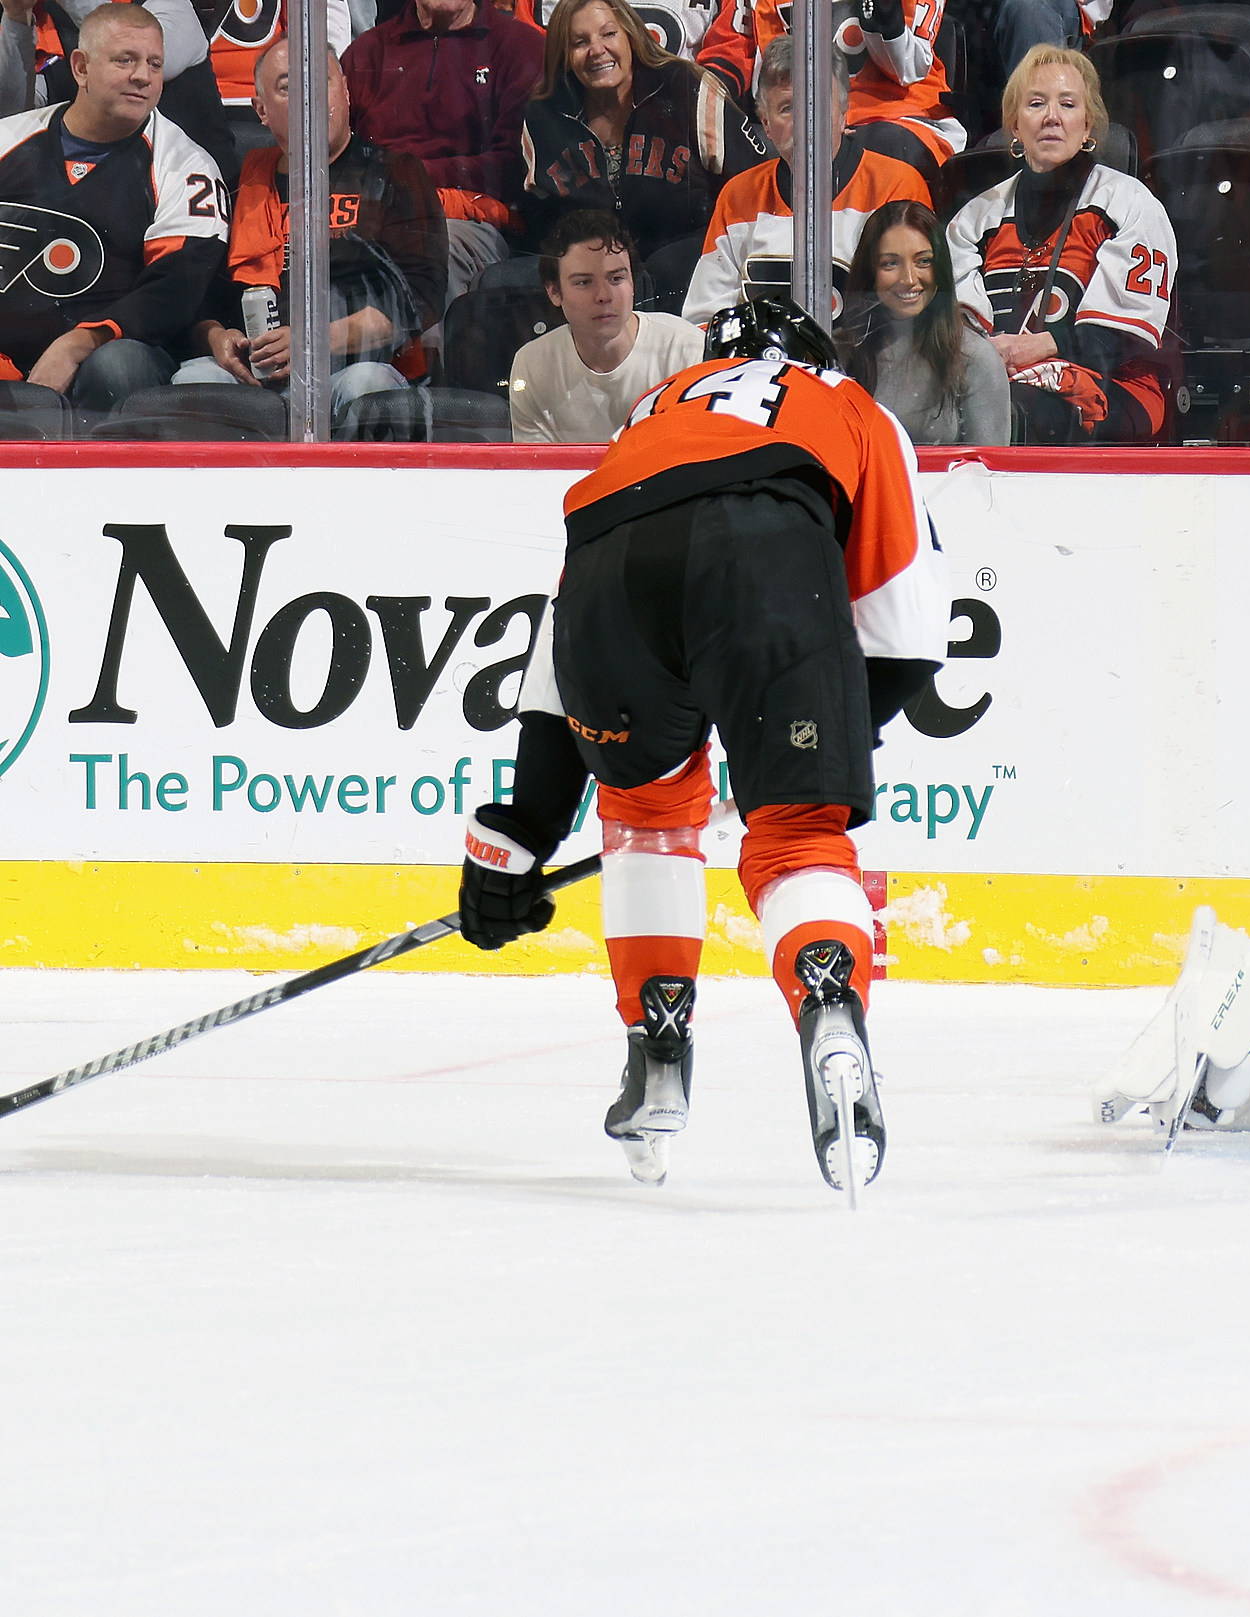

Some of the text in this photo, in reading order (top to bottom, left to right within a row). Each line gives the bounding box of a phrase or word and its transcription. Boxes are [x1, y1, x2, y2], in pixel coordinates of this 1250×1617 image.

[186, 172, 232, 225] 20
[1125, 243, 1169, 302] 27
[68, 523, 1002, 738] Novae
[566, 714, 631, 744] CCM
[69, 753, 189, 812] The
[212, 755, 397, 813] Power
[411, 757, 472, 815] of
[873, 782, 995, 840] rapy
